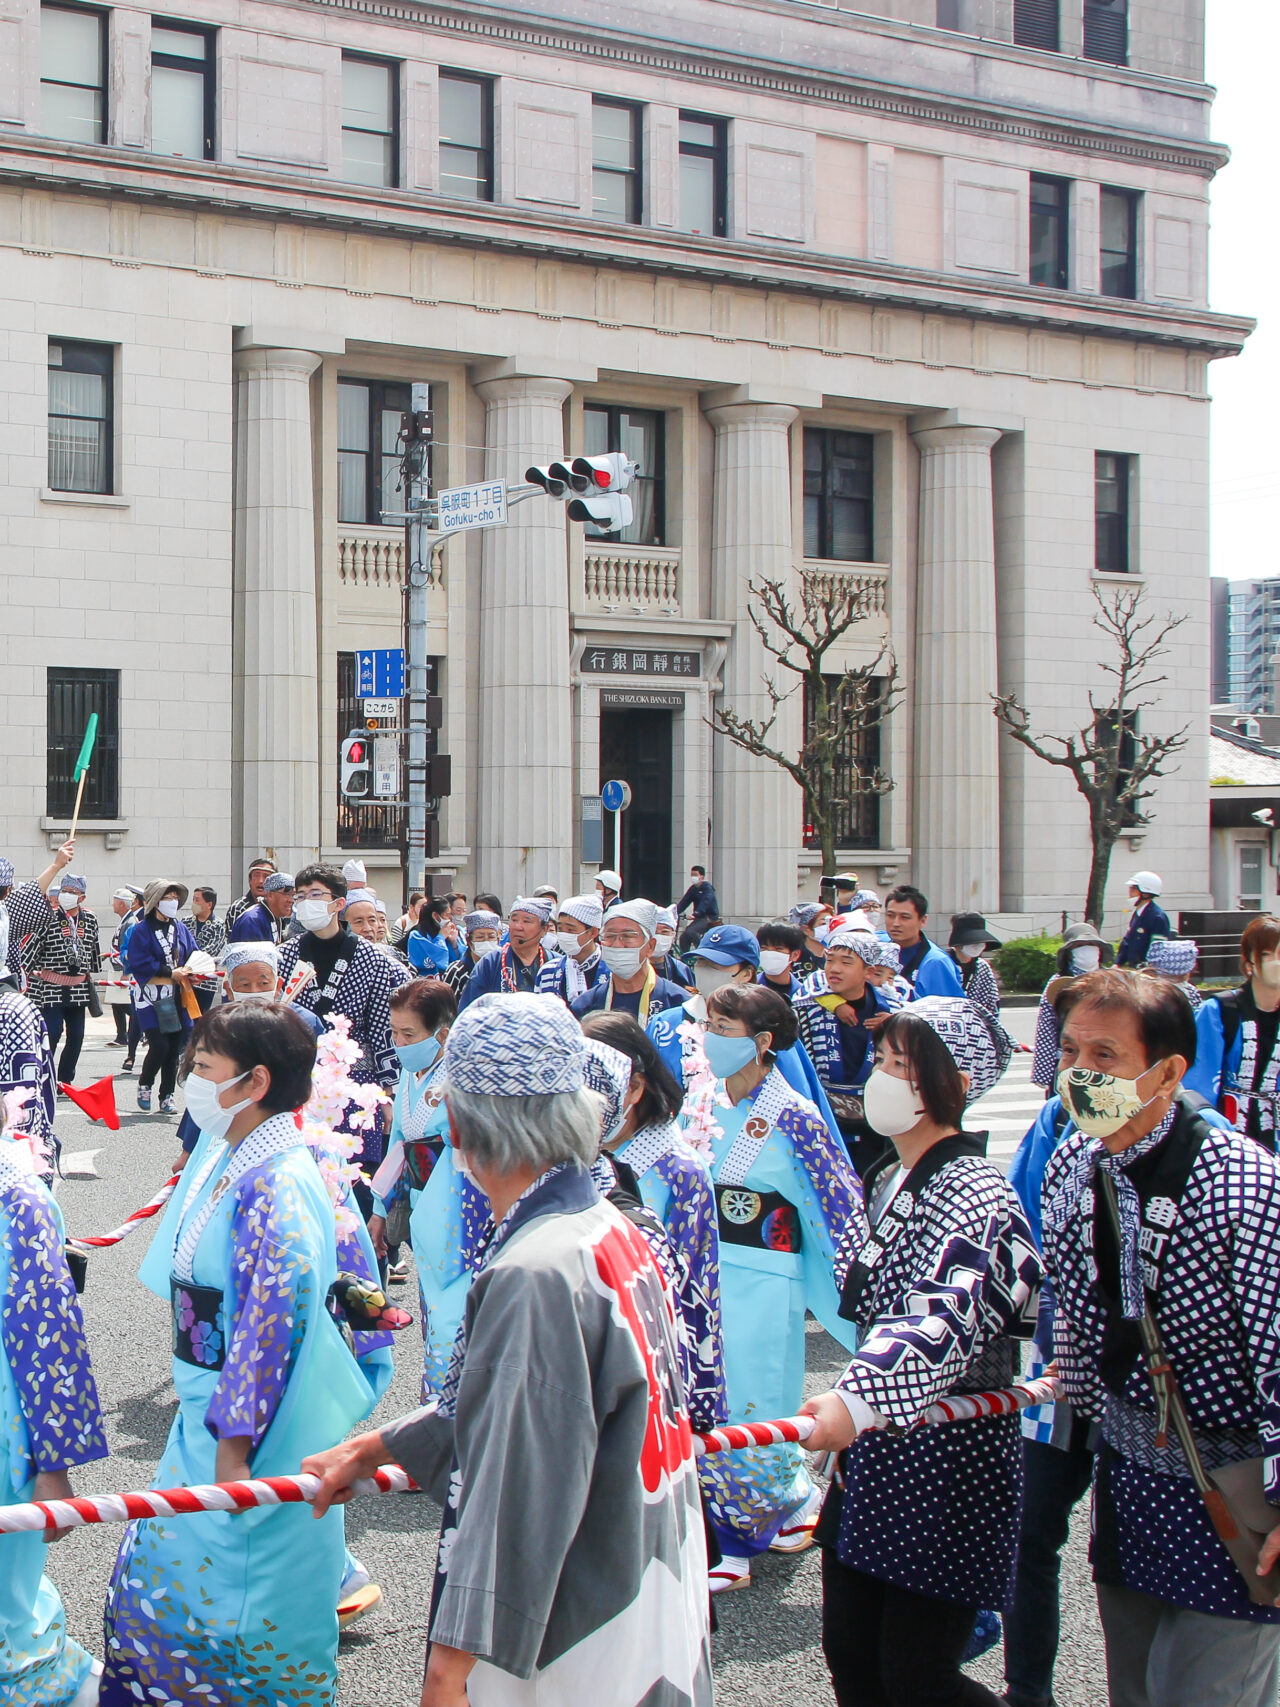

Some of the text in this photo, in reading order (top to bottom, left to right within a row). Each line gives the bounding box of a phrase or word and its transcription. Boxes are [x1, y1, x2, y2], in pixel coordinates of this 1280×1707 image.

[444, 507, 502, 527] Gofuku-cho 1
[604, 694, 682, 705] THE SHIZUOKA BANK LTD.
[366, 704, 394, 712] ここから
